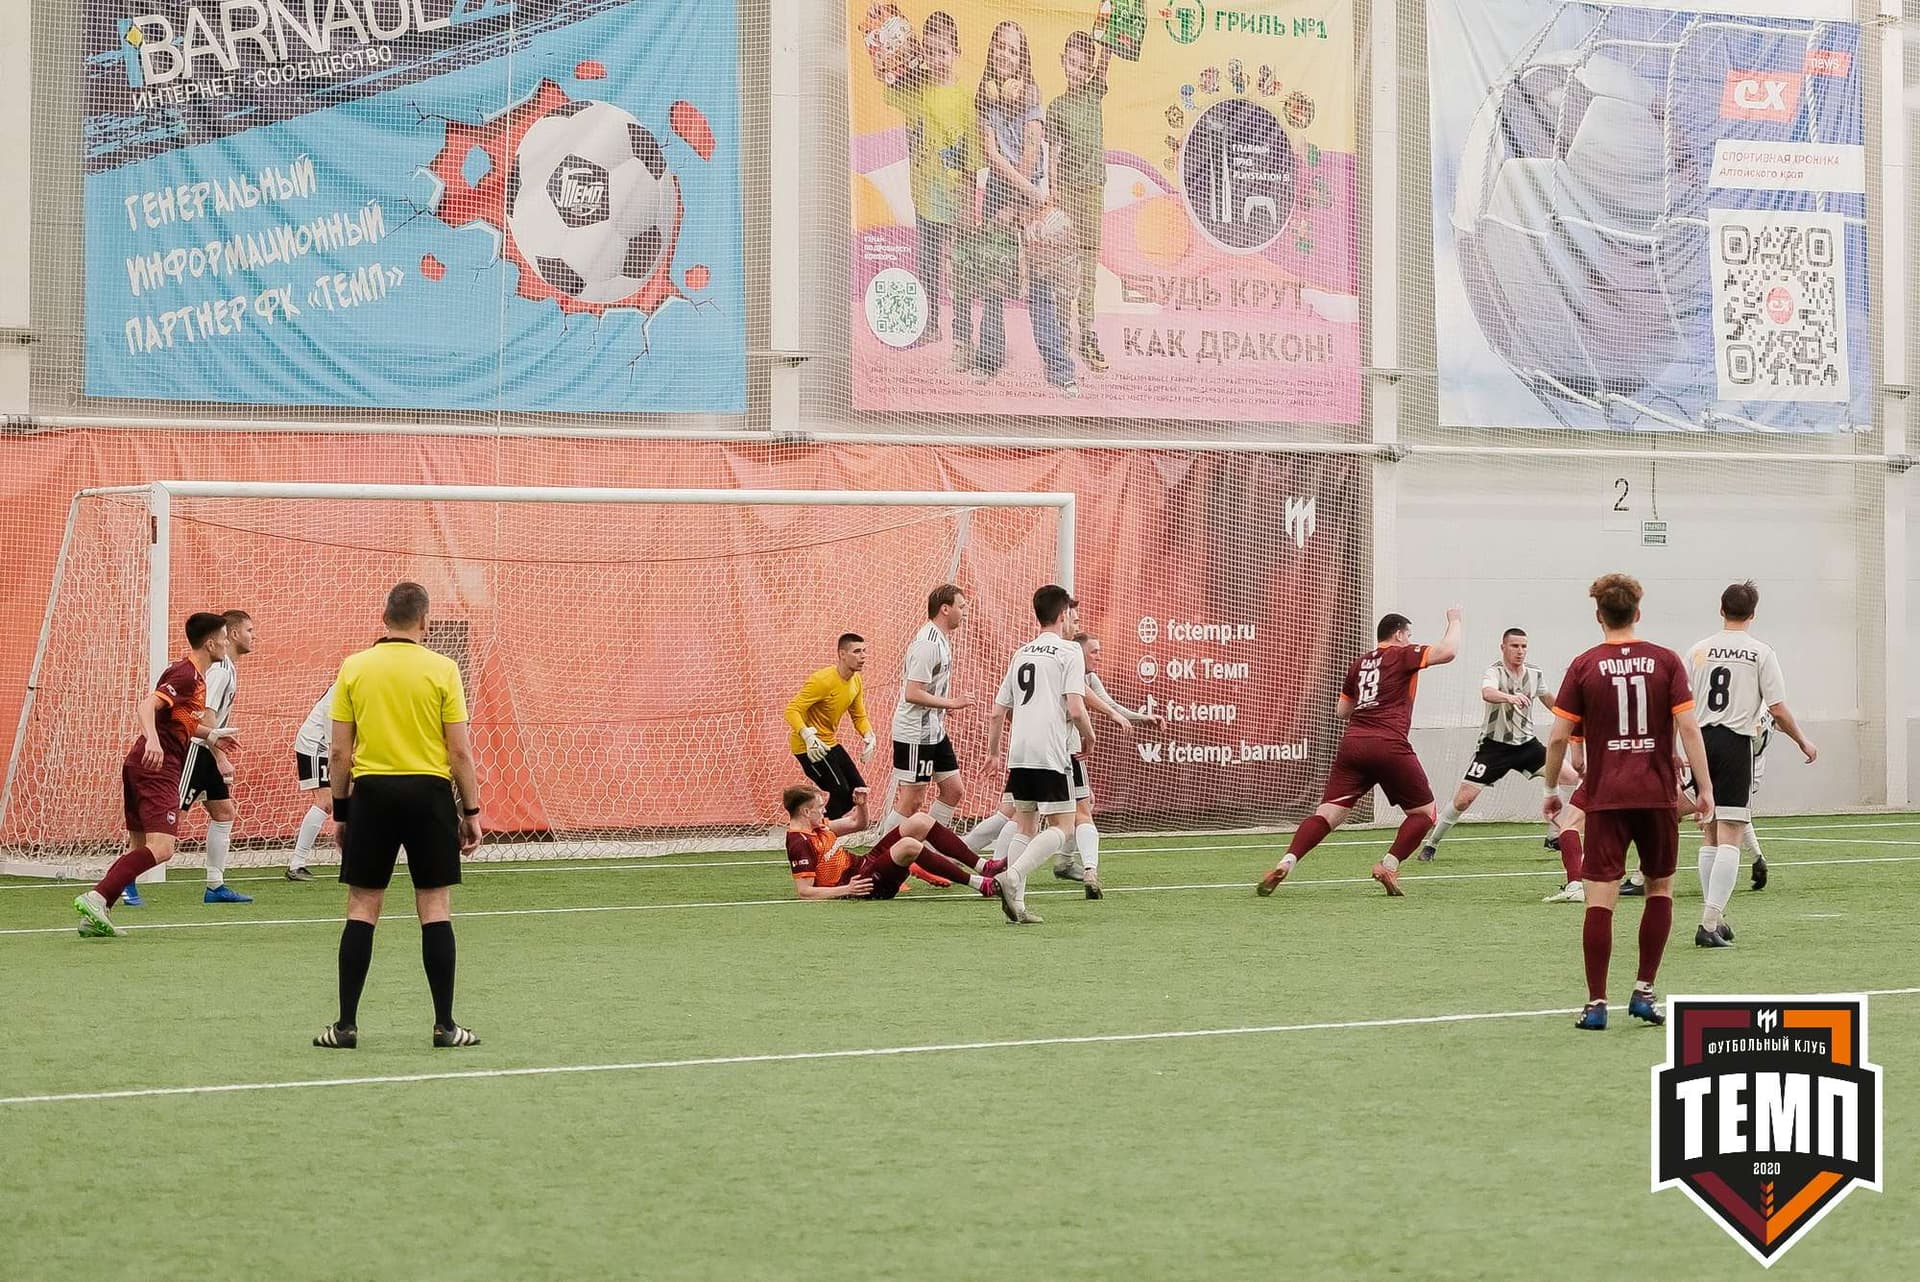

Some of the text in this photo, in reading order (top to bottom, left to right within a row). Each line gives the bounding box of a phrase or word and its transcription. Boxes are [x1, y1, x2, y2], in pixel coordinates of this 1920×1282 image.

[1214, 10, 1328, 39] ГРИЛЬ №1
[1811, 57, 1840, 69] news
[1722, 151, 1791, 164] СПОРТИВНАЯ
[124, 153, 317, 232] ГЕНЕРАЛЬНЫЙ
[126, 198, 386, 297] ИНФОРМАЦИОННЫЙ
[1120, 273, 1222, 311] БУДЬ
[125, 262, 405, 356] ПАРТНЕР ФК «ТЕМП»
[1123, 327, 1335, 364] КАК ДРАКОН!
[1613, 477, 1630, 512] 2
[1166, 619, 1256, 645] fctemp.ru
[1166, 658, 1249, 680] ФК Темп
[1598, 656, 1656, 676] РОДИЧЕВ
[1707, 647, 1759, 663] АЛМАЗ
[1017, 661, 1036, 706] 9
[1357, 667, 1381, 705] 13
[1707, 665, 1732, 714] 8
[1166, 699, 1237, 726] fc.temp
[1611, 674, 1648, 737] 11
[1167, 737, 1309, 766] fctemp_barnaul
[1607, 738, 1656, 751] SEUS
[918, 759, 934, 777] 10
[1467, 761, 1488, 779] 19
[185, 788, 196, 805] 5
